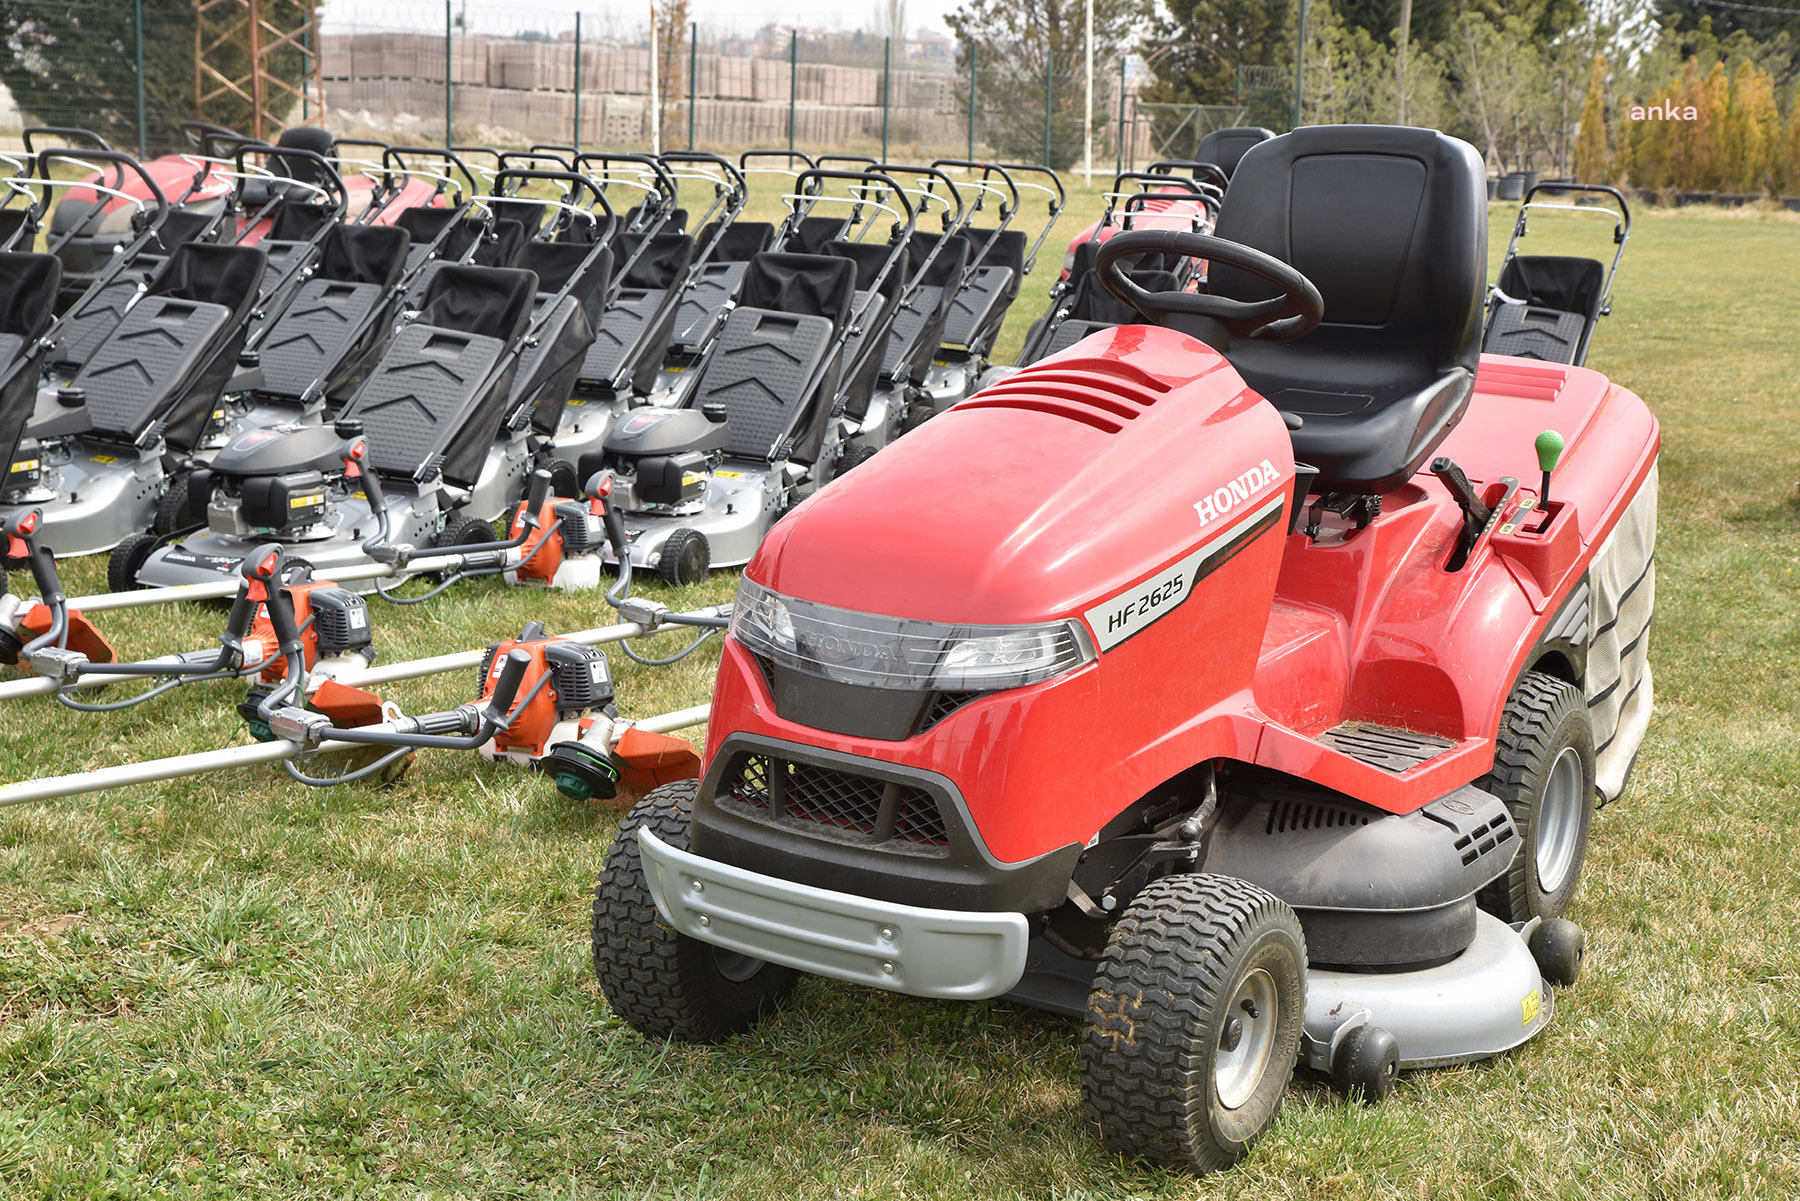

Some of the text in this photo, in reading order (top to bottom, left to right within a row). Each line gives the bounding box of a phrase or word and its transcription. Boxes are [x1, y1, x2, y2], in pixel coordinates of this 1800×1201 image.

[1192, 459, 1281, 527] HONDA
[1108, 573, 1183, 633] HF 2625
[801, 630, 898, 661] HONDA
